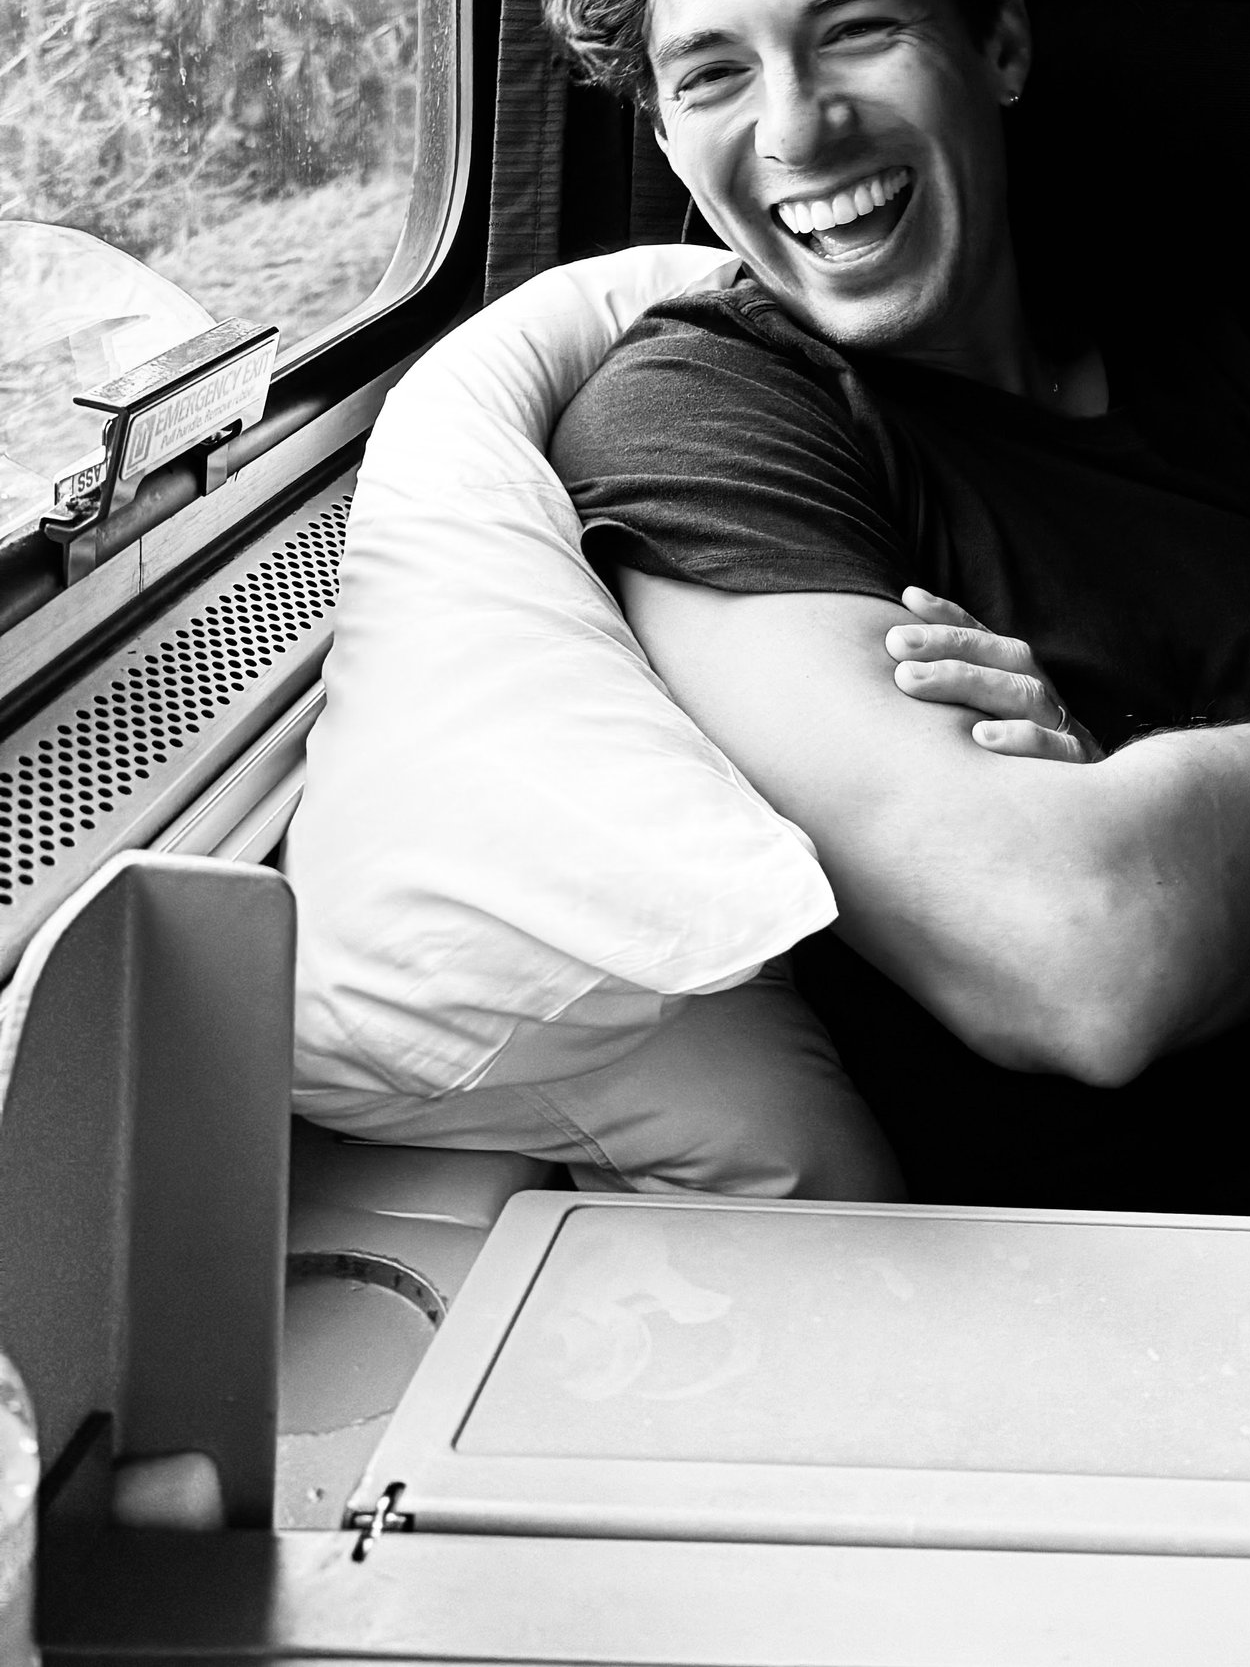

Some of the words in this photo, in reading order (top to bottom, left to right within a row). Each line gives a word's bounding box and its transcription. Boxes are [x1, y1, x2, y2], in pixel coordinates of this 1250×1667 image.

[155, 366, 242, 437] EMERGENCY
[242, 349, 273, 386] EXIT
[160, 426, 177, 450] Pull
